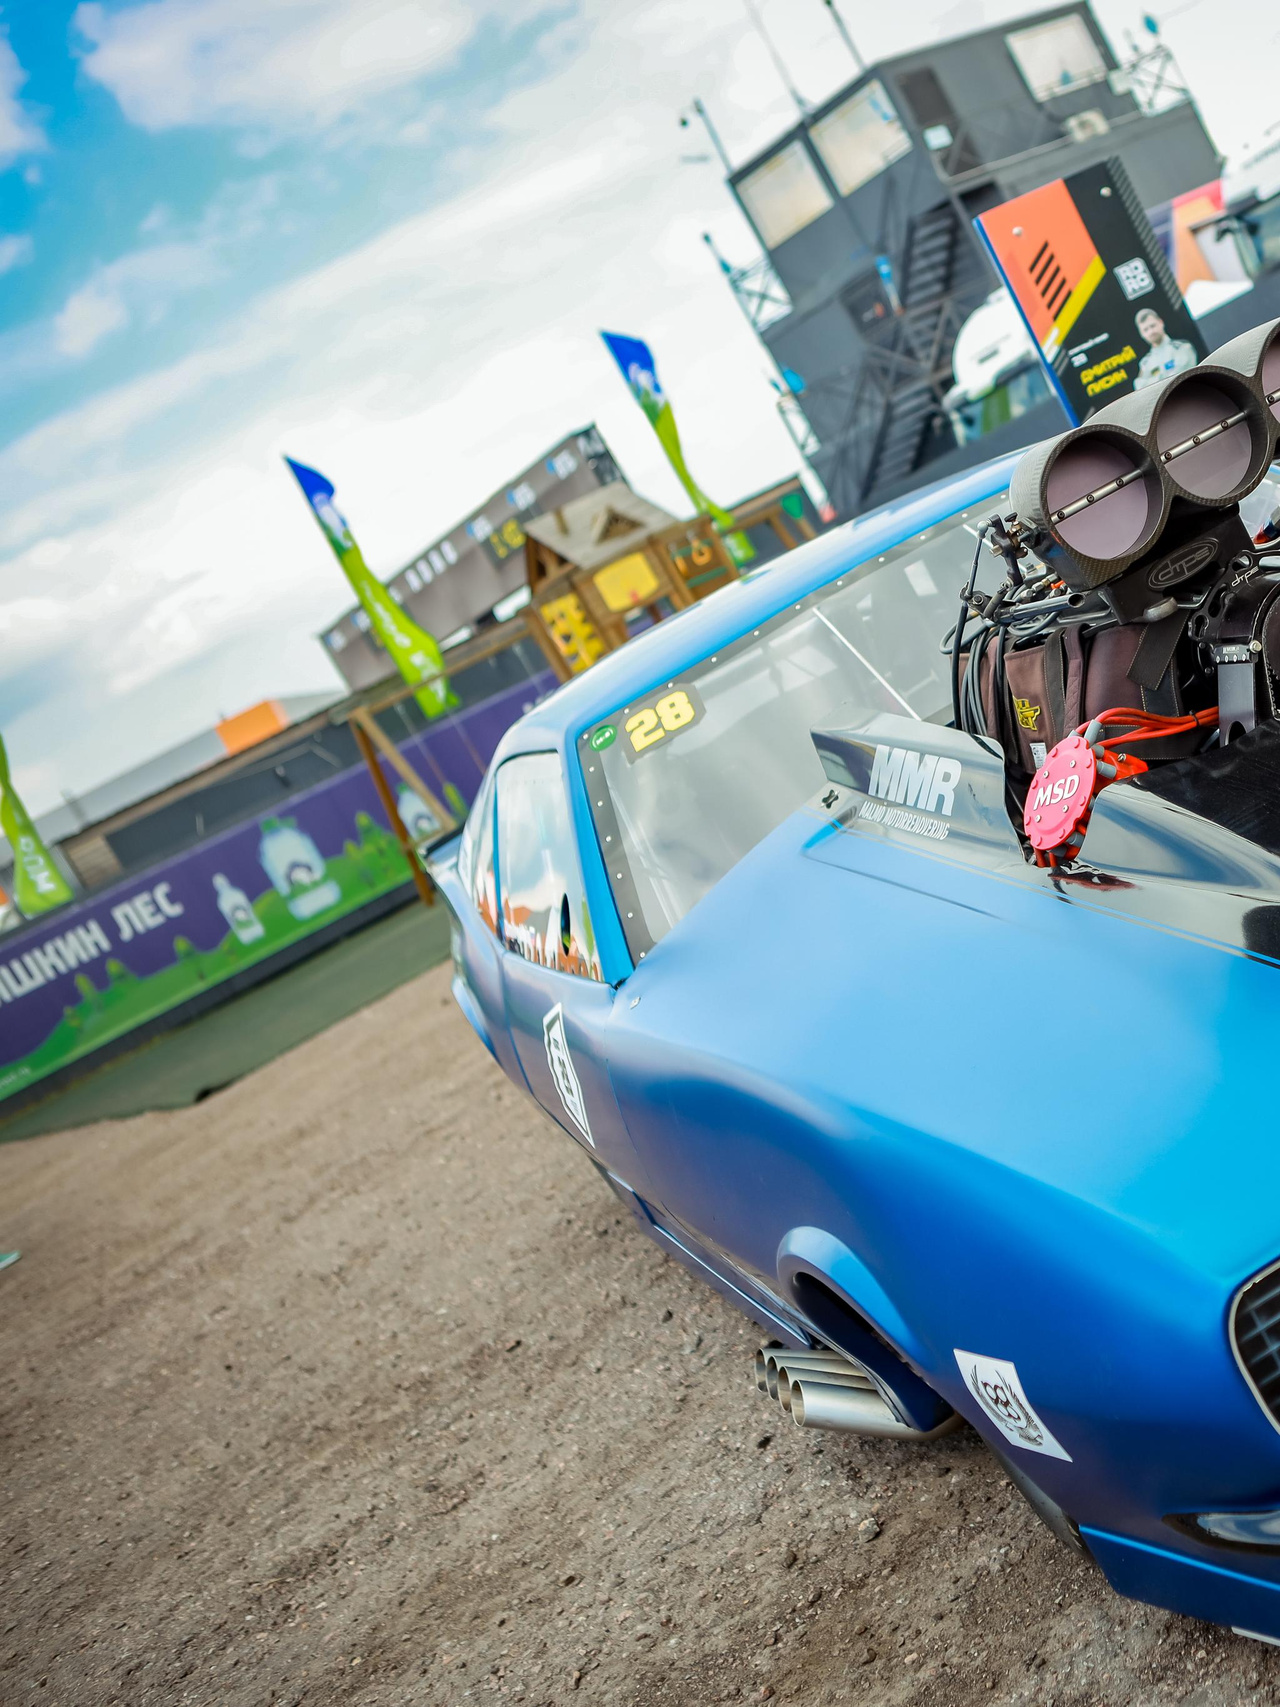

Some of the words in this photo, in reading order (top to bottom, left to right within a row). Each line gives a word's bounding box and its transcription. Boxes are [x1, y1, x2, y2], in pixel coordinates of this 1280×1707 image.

[1080, 345, 1137, 385] ДМИТРИЙ
[624, 690, 695, 752] 28
[868, 744, 962, 816] MMR
[1033, 774, 1080, 811] MSD
[881, 807, 950, 841] MOTORRENOVERING
[110, 881, 185, 943] ЛЕС
